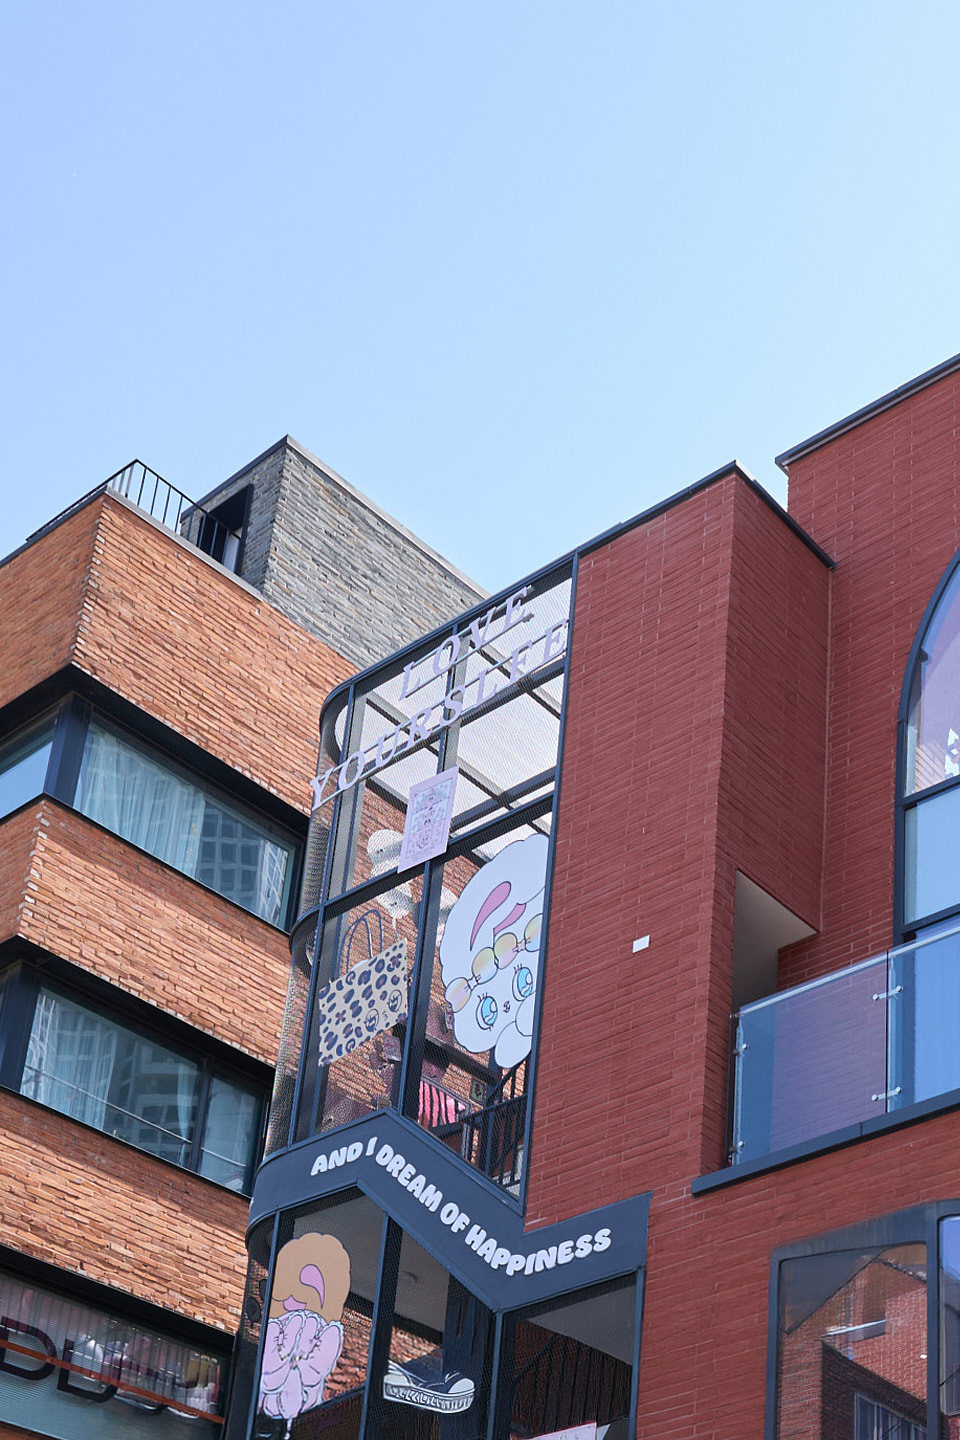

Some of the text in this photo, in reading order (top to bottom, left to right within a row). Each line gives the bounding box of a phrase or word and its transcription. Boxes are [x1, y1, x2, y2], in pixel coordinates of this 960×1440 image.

[400, 585, 532, 701] LOVE
[311, 1136, 612, 1276] AND I DREAM OF HAPPINESS
